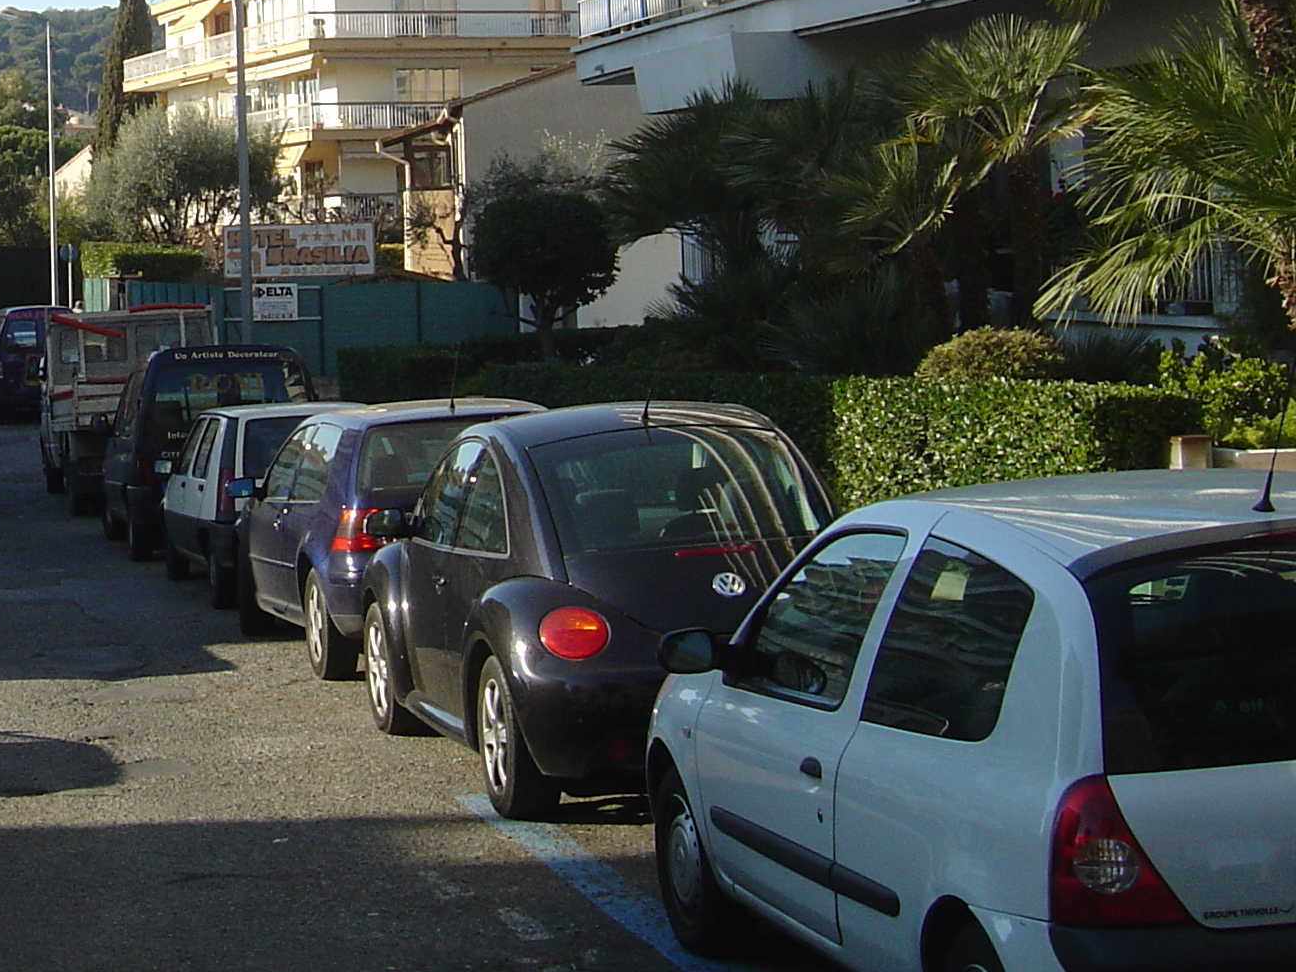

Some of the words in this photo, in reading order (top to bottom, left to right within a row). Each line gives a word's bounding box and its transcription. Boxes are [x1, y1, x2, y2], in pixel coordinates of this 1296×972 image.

[266, 245, 370, 266] BRASILIA
[258, 287, 293, 298] DELTA
[191, 351, 224, 360] Artiste
[186, 373, 263, 395] RONI
[1203, 910, 1238, 919] GROUPE
